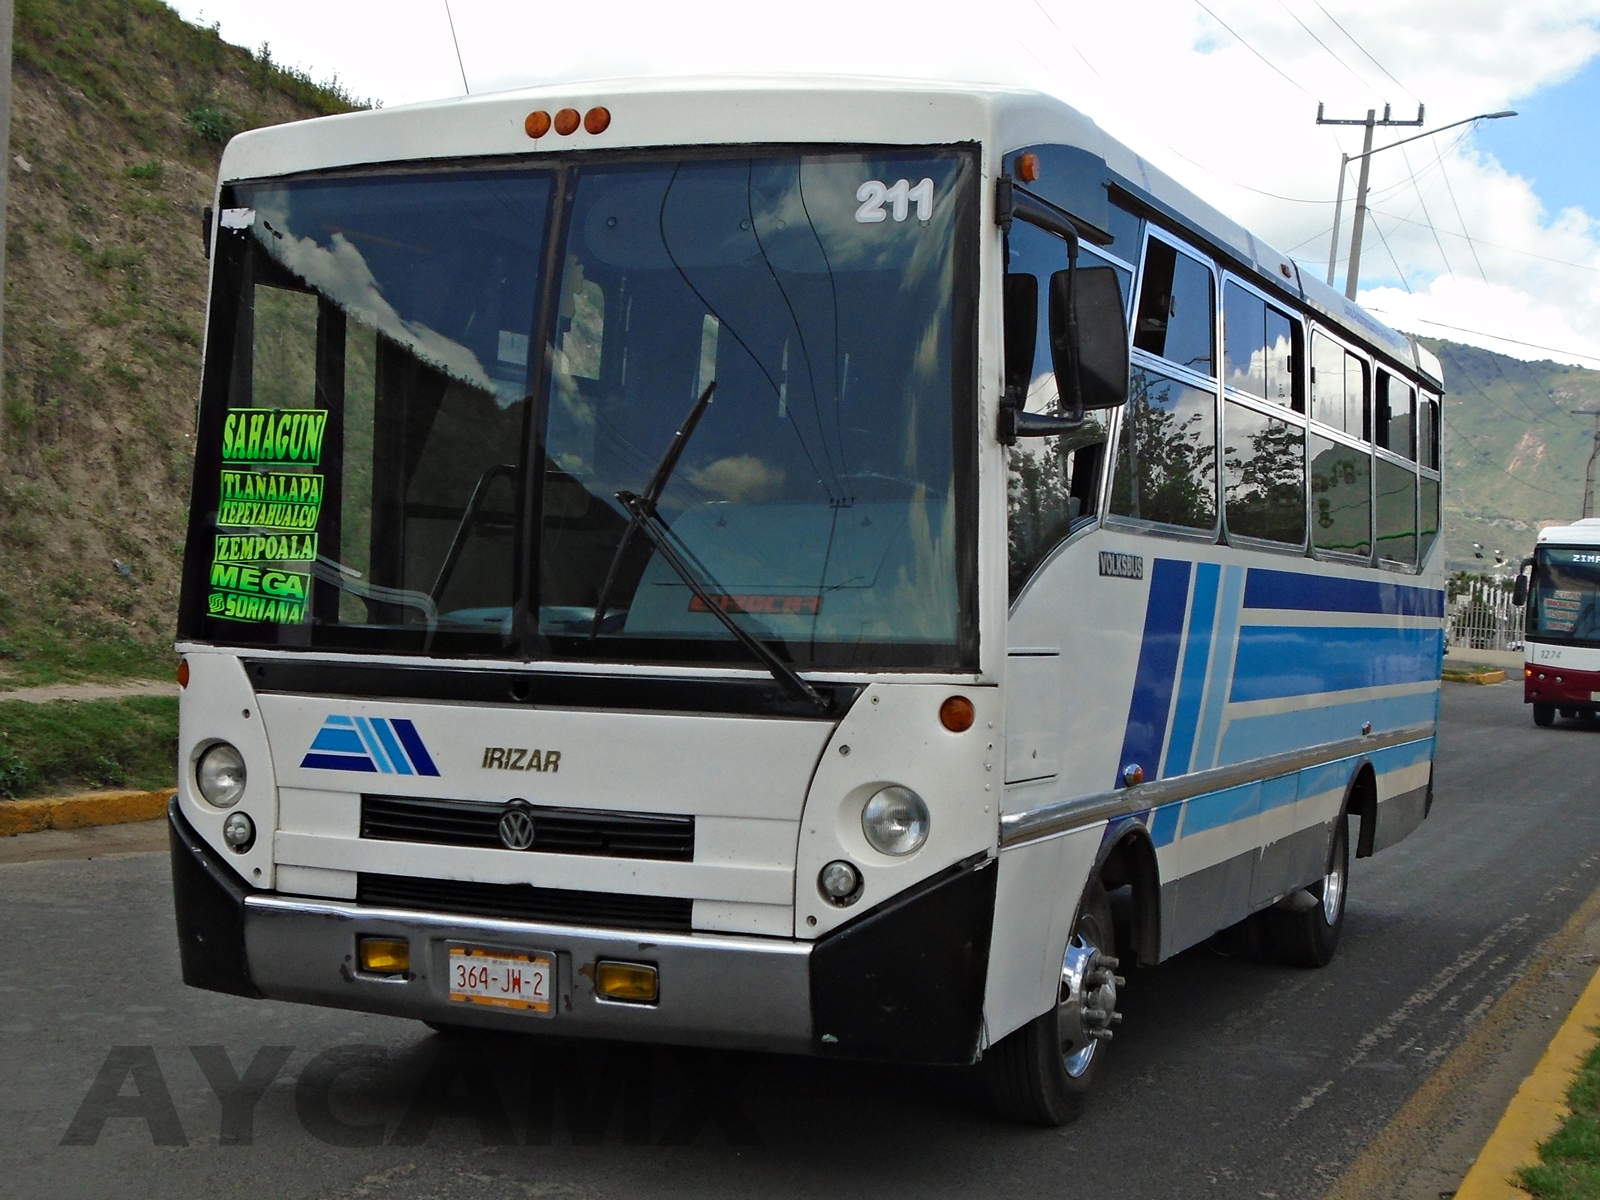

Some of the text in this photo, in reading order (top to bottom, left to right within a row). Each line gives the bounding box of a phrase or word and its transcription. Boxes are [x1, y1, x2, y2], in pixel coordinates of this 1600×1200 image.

[855, 178, 934, 223] 211
[222, 413, 323, 460] SAHAGUN
[224, 473, 319, 503] TLANALAPA
[221, 501, 317, 528] TEPEYAHUALCO
[218, 535, 313, 561] ZEMPOALA
[1099, 552, 1143, 578] VOLKSBUS
[210, 564, 304, 599] MEGA
[225, 595, 299, 625] SORIANA
[1540, 649, 1562, 660] 1274
[481, 747, 562, 773] IRIZAR
[456, 964, 543, 996] 364-JW-2
